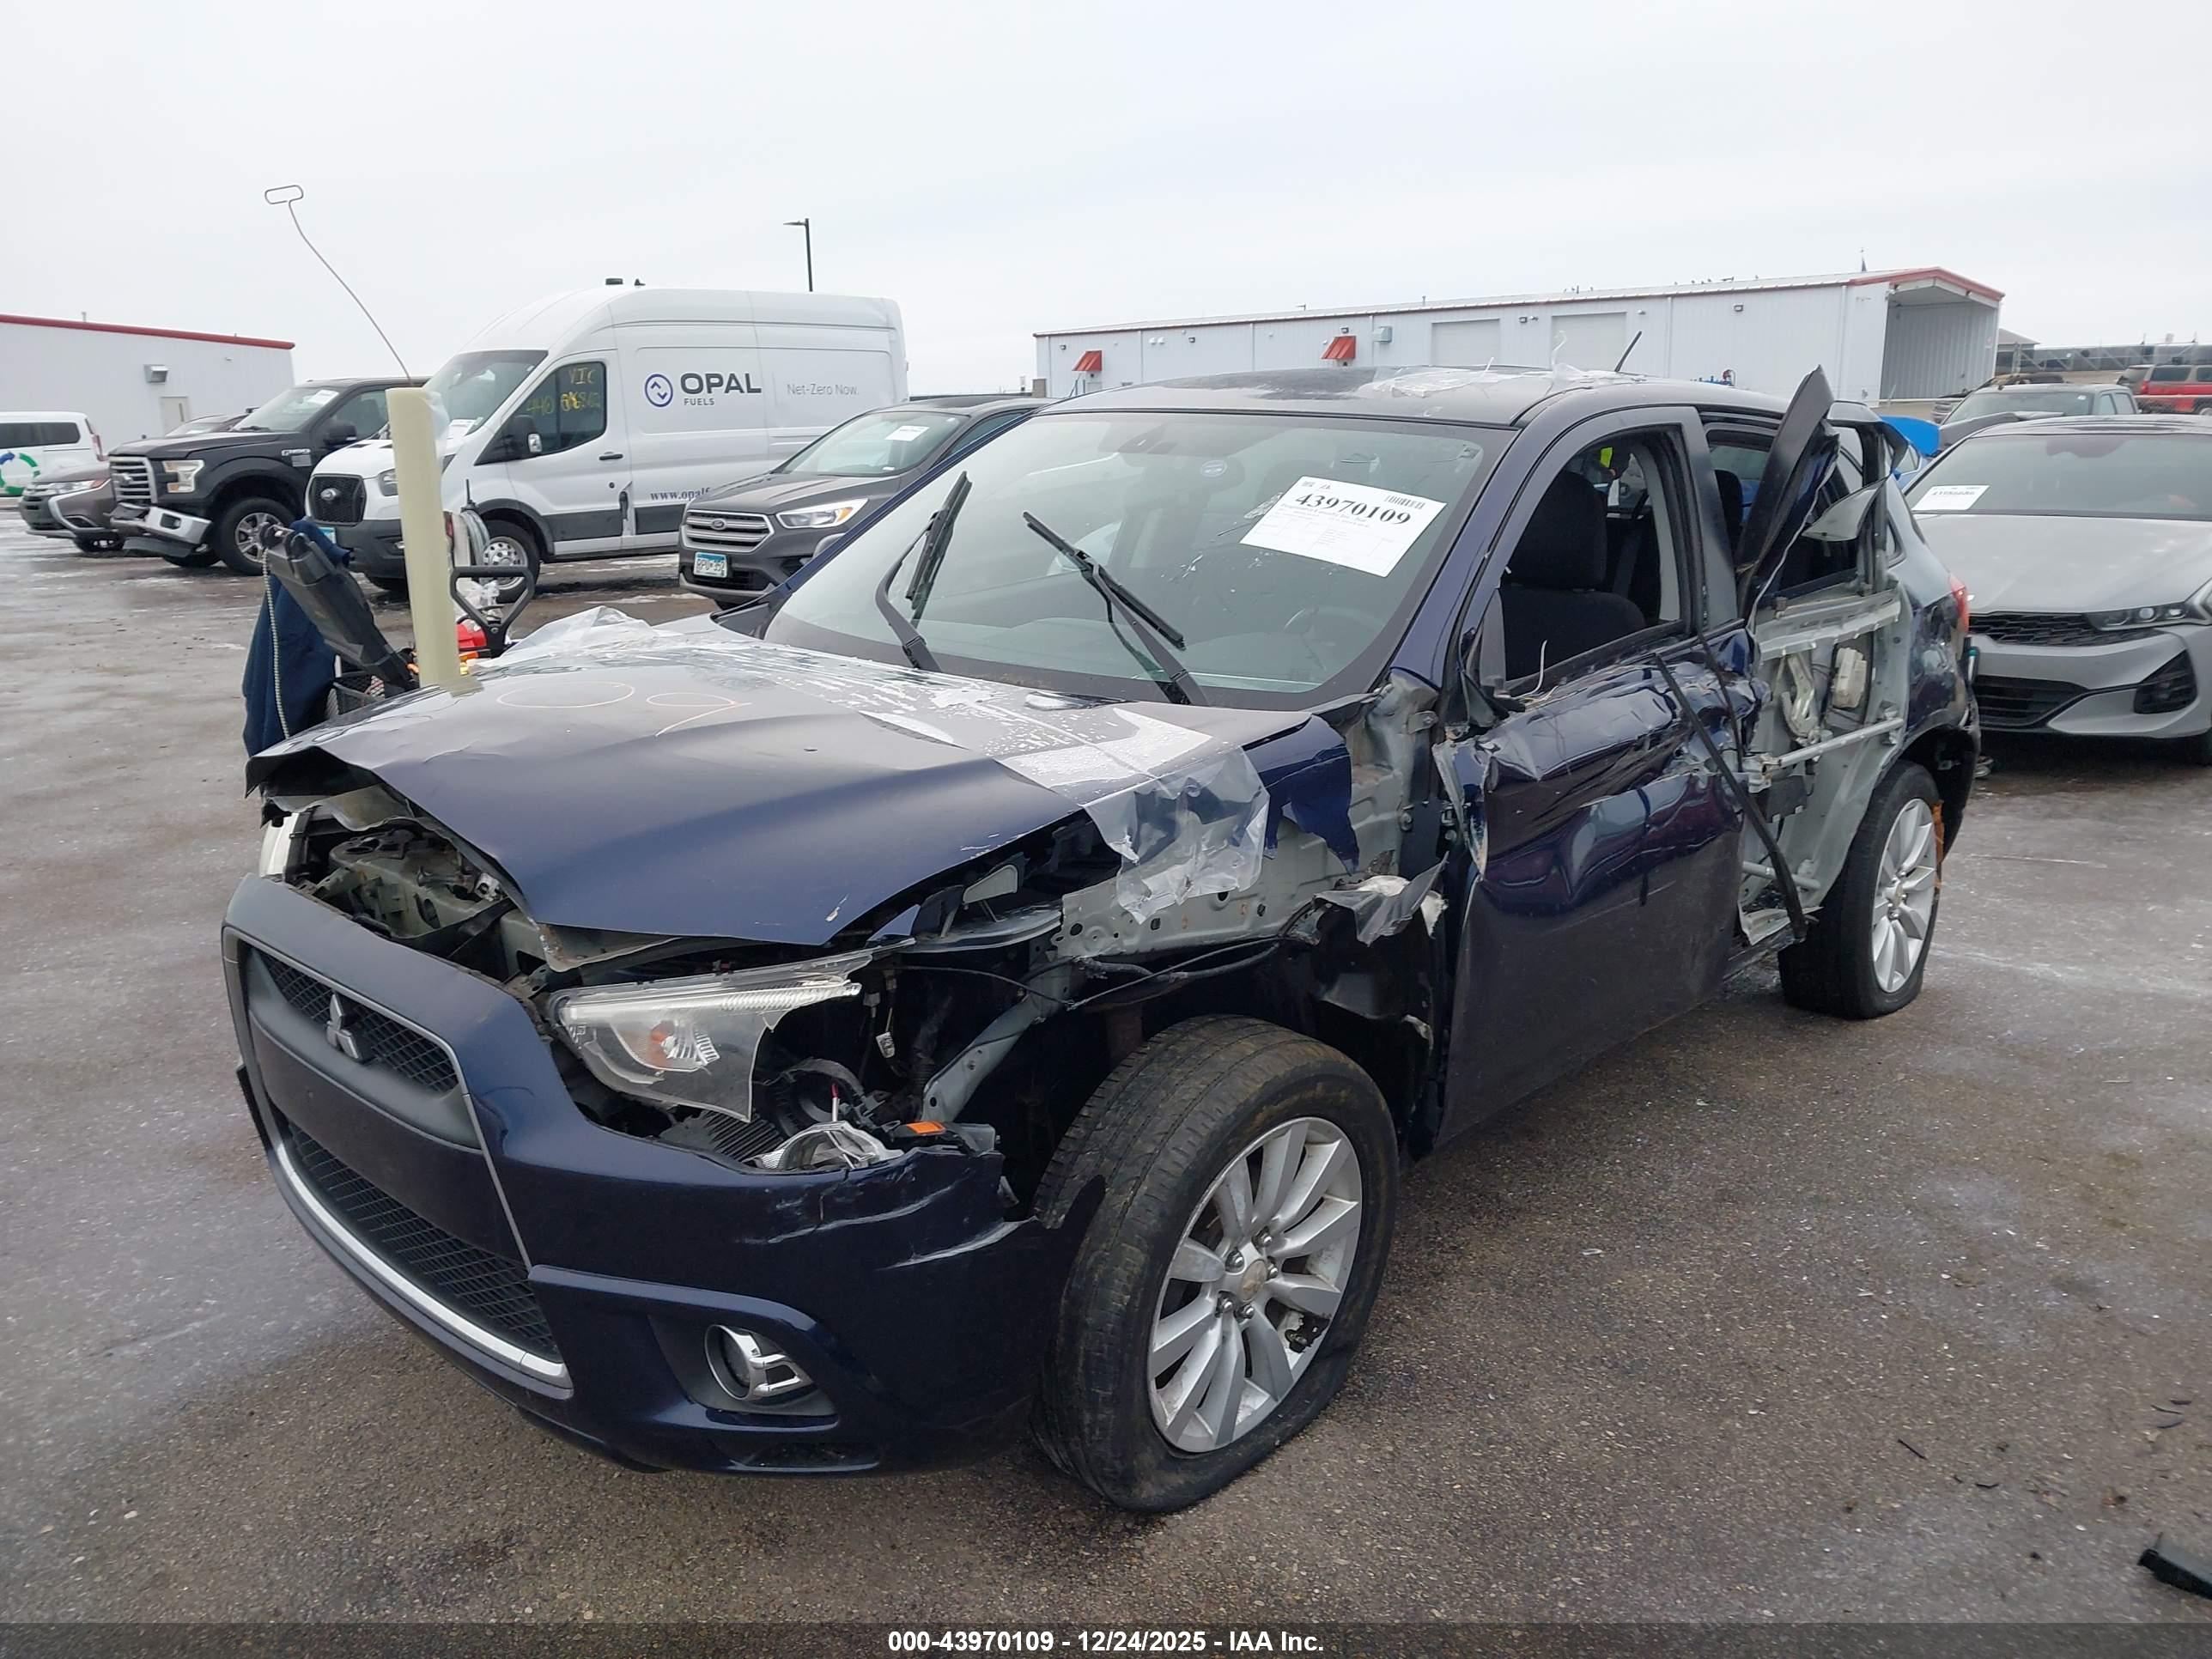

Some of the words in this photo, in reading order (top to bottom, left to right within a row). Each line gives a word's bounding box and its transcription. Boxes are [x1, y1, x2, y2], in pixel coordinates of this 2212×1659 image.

[680, 373, 763, 394] OPAL
[787, 384, 833, 396] Net-Zero
[684, 398, 715, 406] FUELS
[1295, 493, 1413, 526] 43970109
